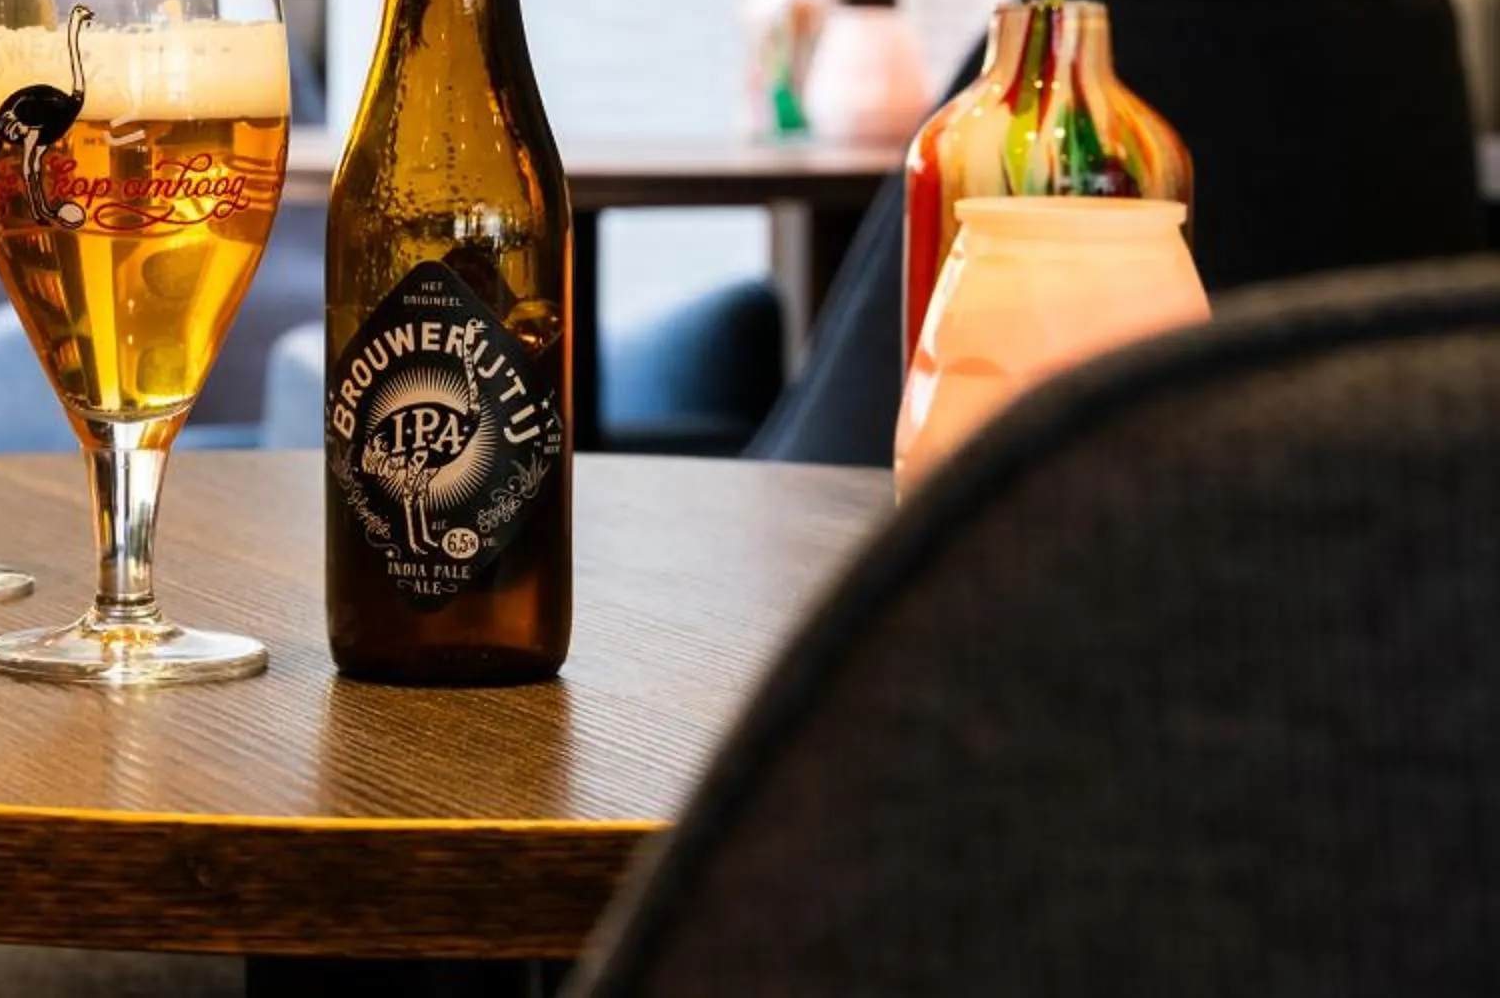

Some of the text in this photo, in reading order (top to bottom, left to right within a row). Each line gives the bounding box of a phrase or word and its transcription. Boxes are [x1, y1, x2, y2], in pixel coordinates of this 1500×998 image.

[122, 153, 252, 212] omhoog
[387, 561, 471, 580] INDIA PALE
[413, 580, 442, 595] ALE
